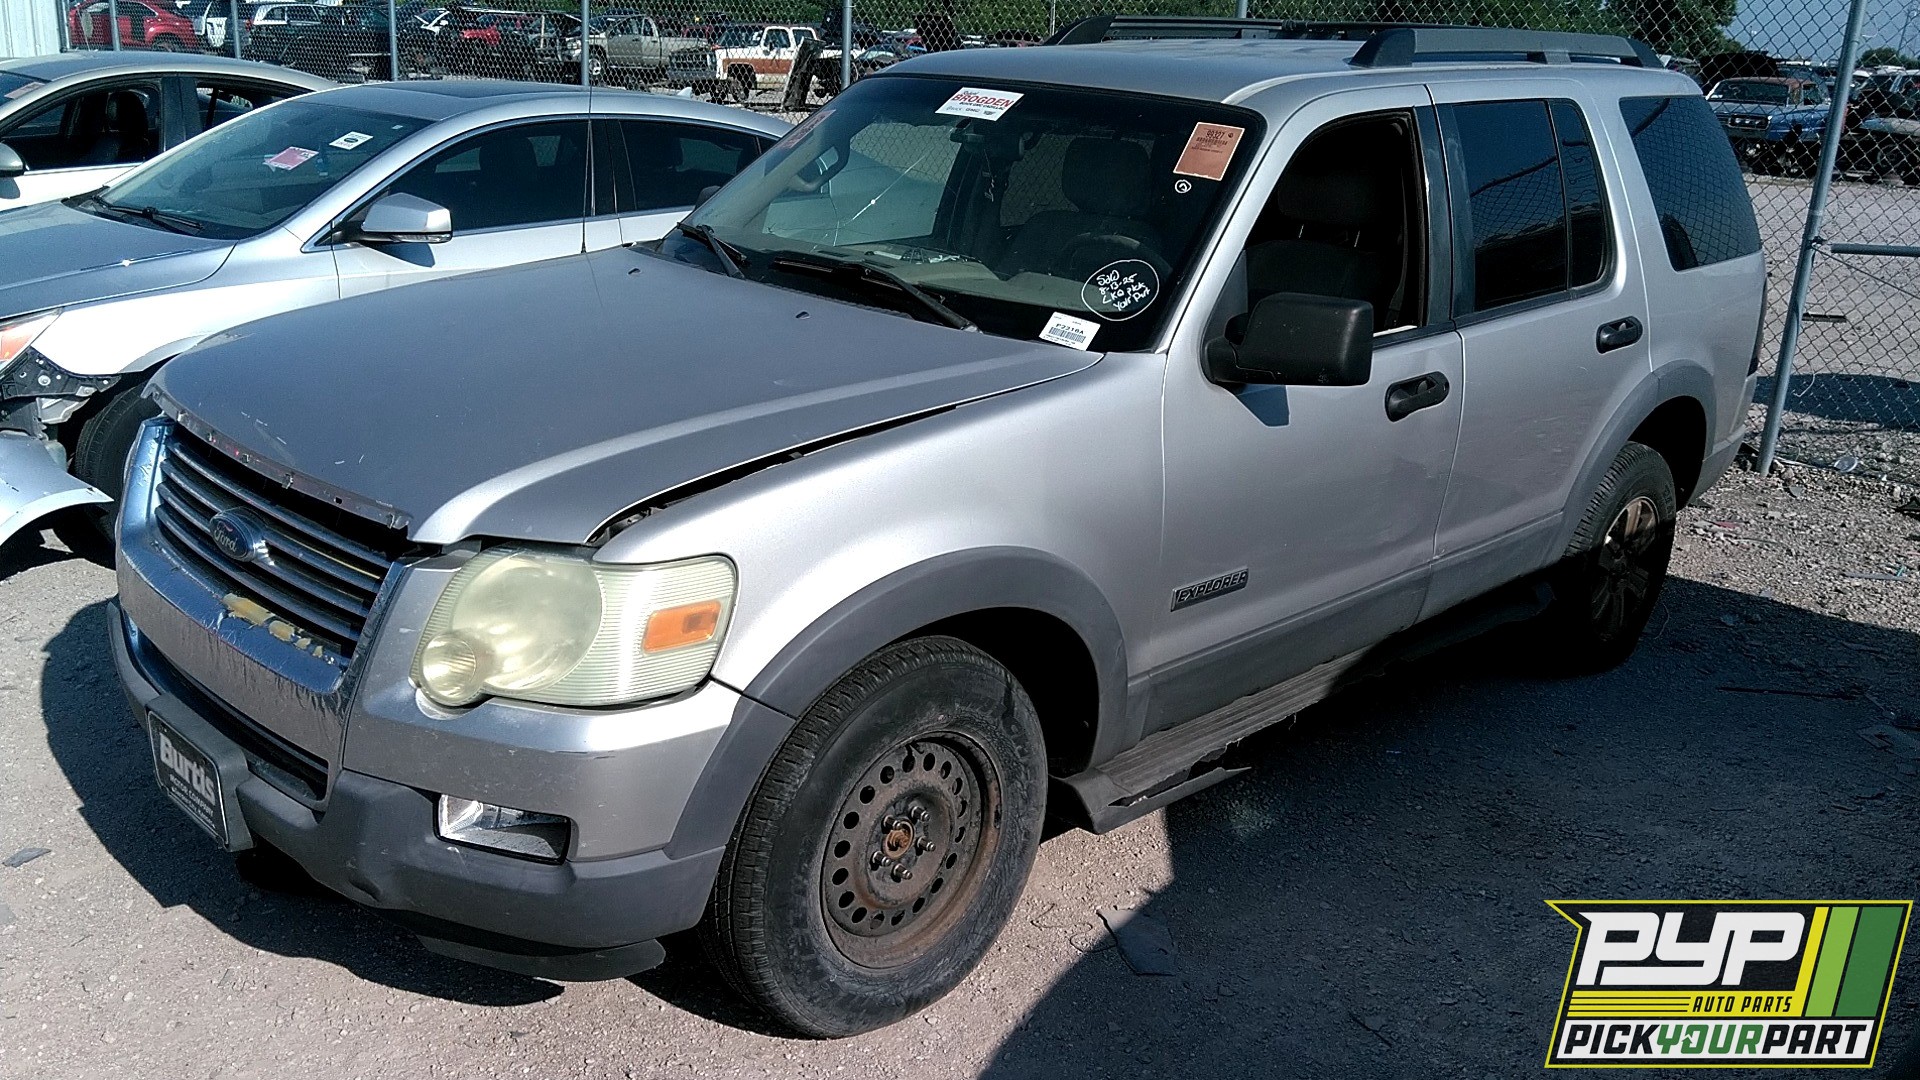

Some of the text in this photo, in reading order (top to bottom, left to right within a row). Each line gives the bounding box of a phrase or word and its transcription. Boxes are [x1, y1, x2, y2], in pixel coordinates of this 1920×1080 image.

[951, 93, 1015, 108] BROGDEN
[1206, 129, 1226, 140] 99327
[213, 520, 239, 553] Ford
[1177, 571, 1248, 602] EXPLORER
[159, 732, 216, 806] Burtis
